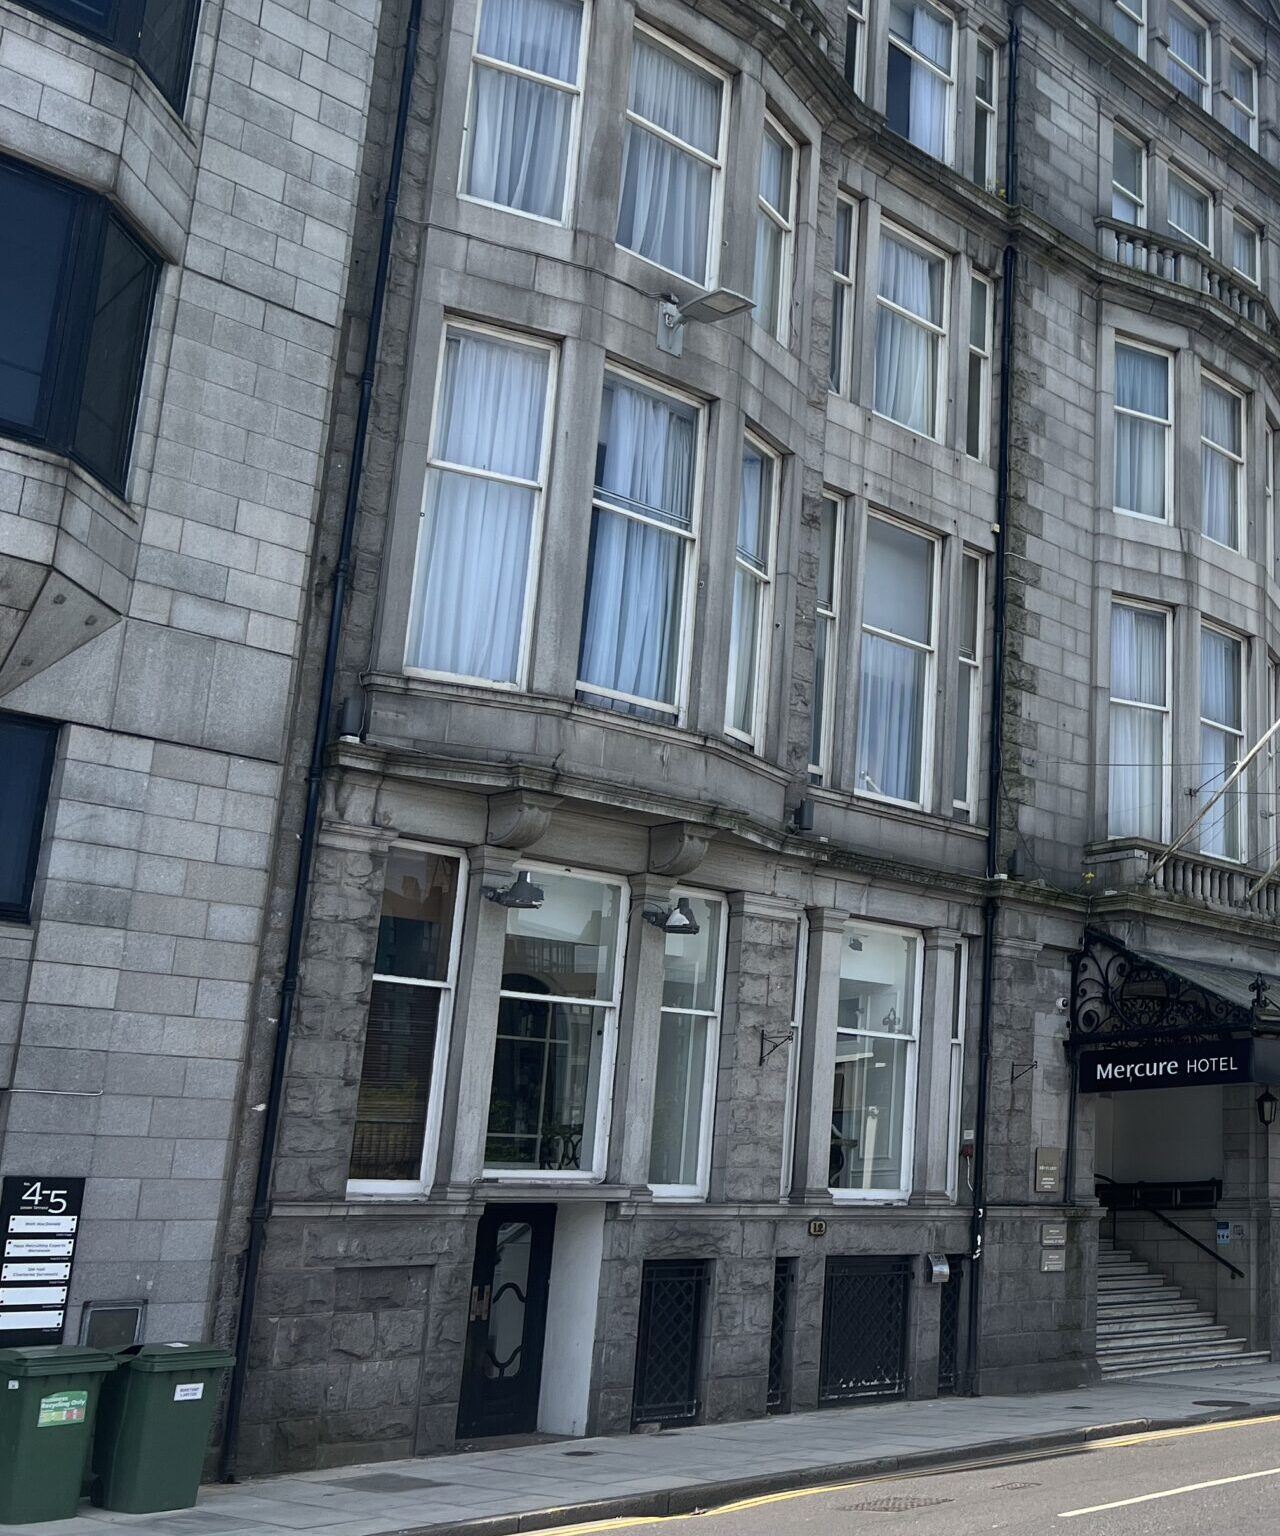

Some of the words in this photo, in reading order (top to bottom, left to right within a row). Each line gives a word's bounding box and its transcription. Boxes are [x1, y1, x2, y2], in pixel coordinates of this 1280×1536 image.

[1096, 1058, 1179, 1081] Mercure
[1186, 1056, 1239, 1074] HOTEL
[813, 1222, 824, 1233] 12
